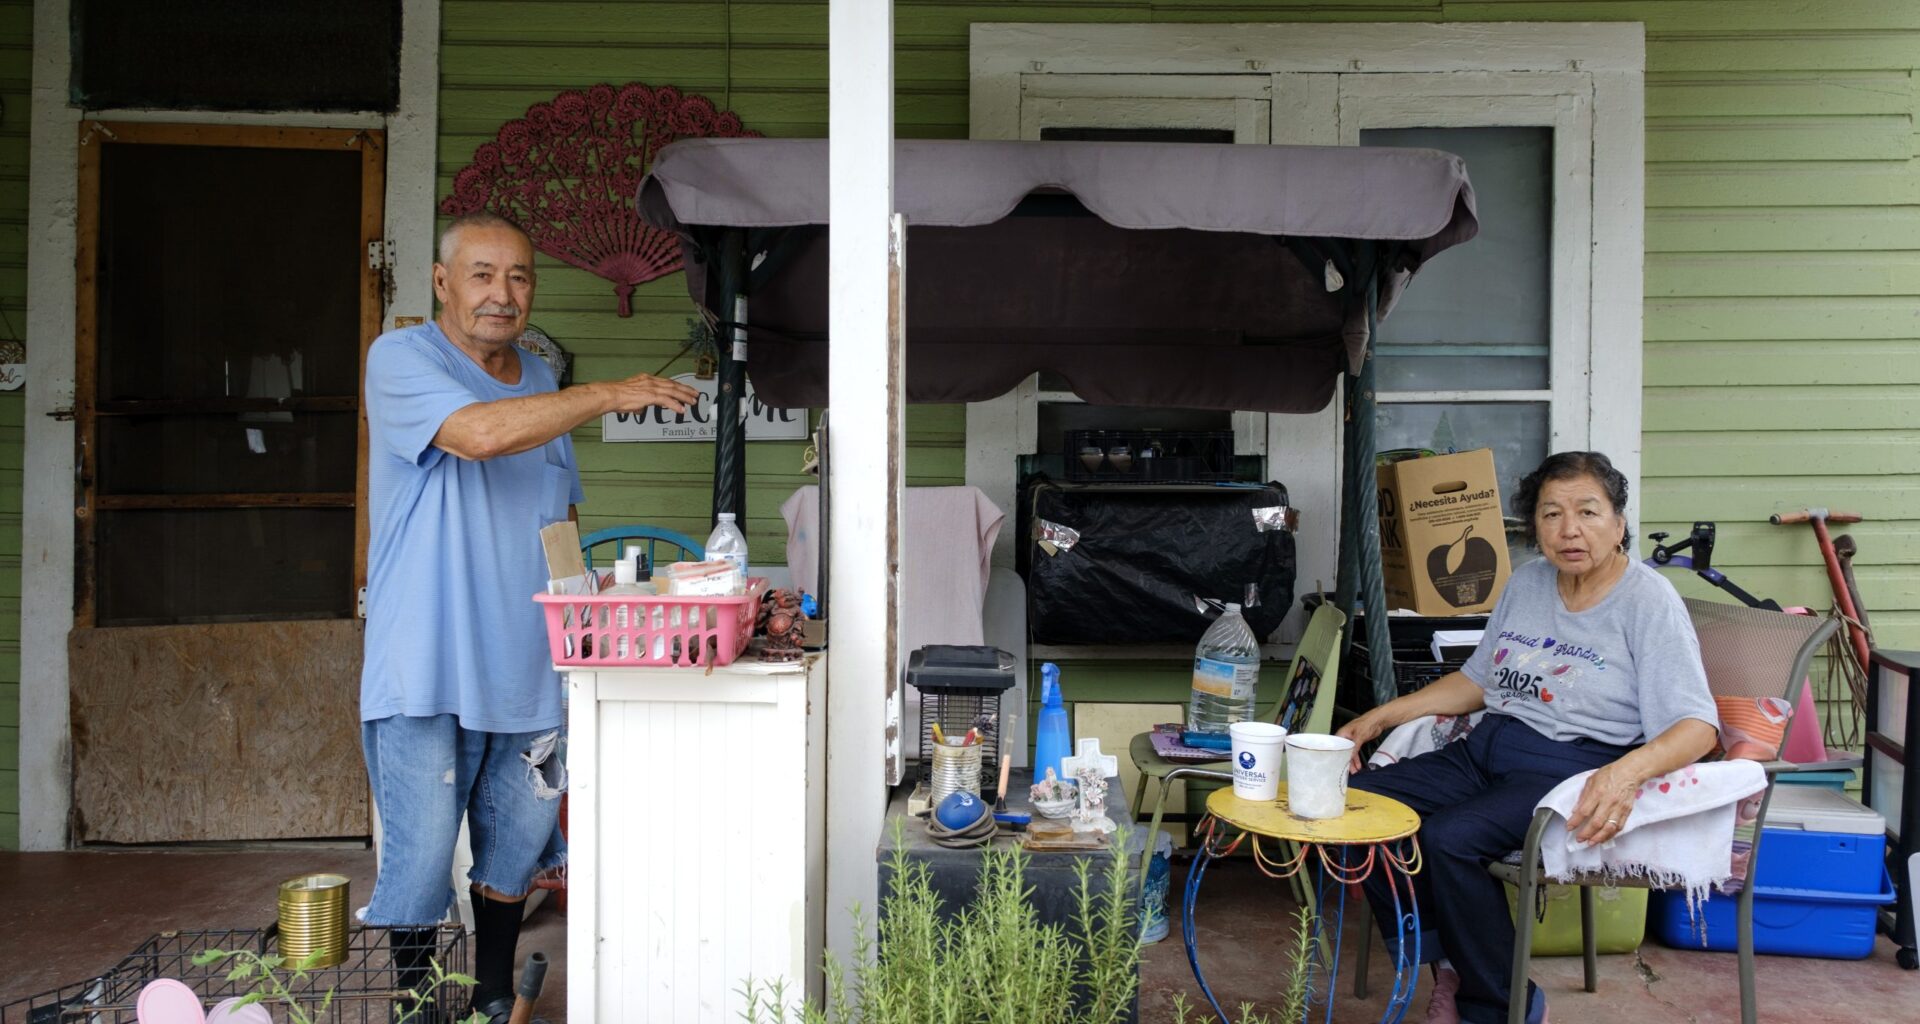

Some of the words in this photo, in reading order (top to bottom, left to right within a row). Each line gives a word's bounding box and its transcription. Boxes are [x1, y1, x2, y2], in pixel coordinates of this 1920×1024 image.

[662, 427, 695, 438] Family
[699, 427, 708, 437] &
[1409, 495, 1457, 512] ¿Necesita
[1459, 489, 1495, 503] Ayuda?
[1499, 631, 1541, 648] proud
[1498, 667, 1544, 698] 2025
